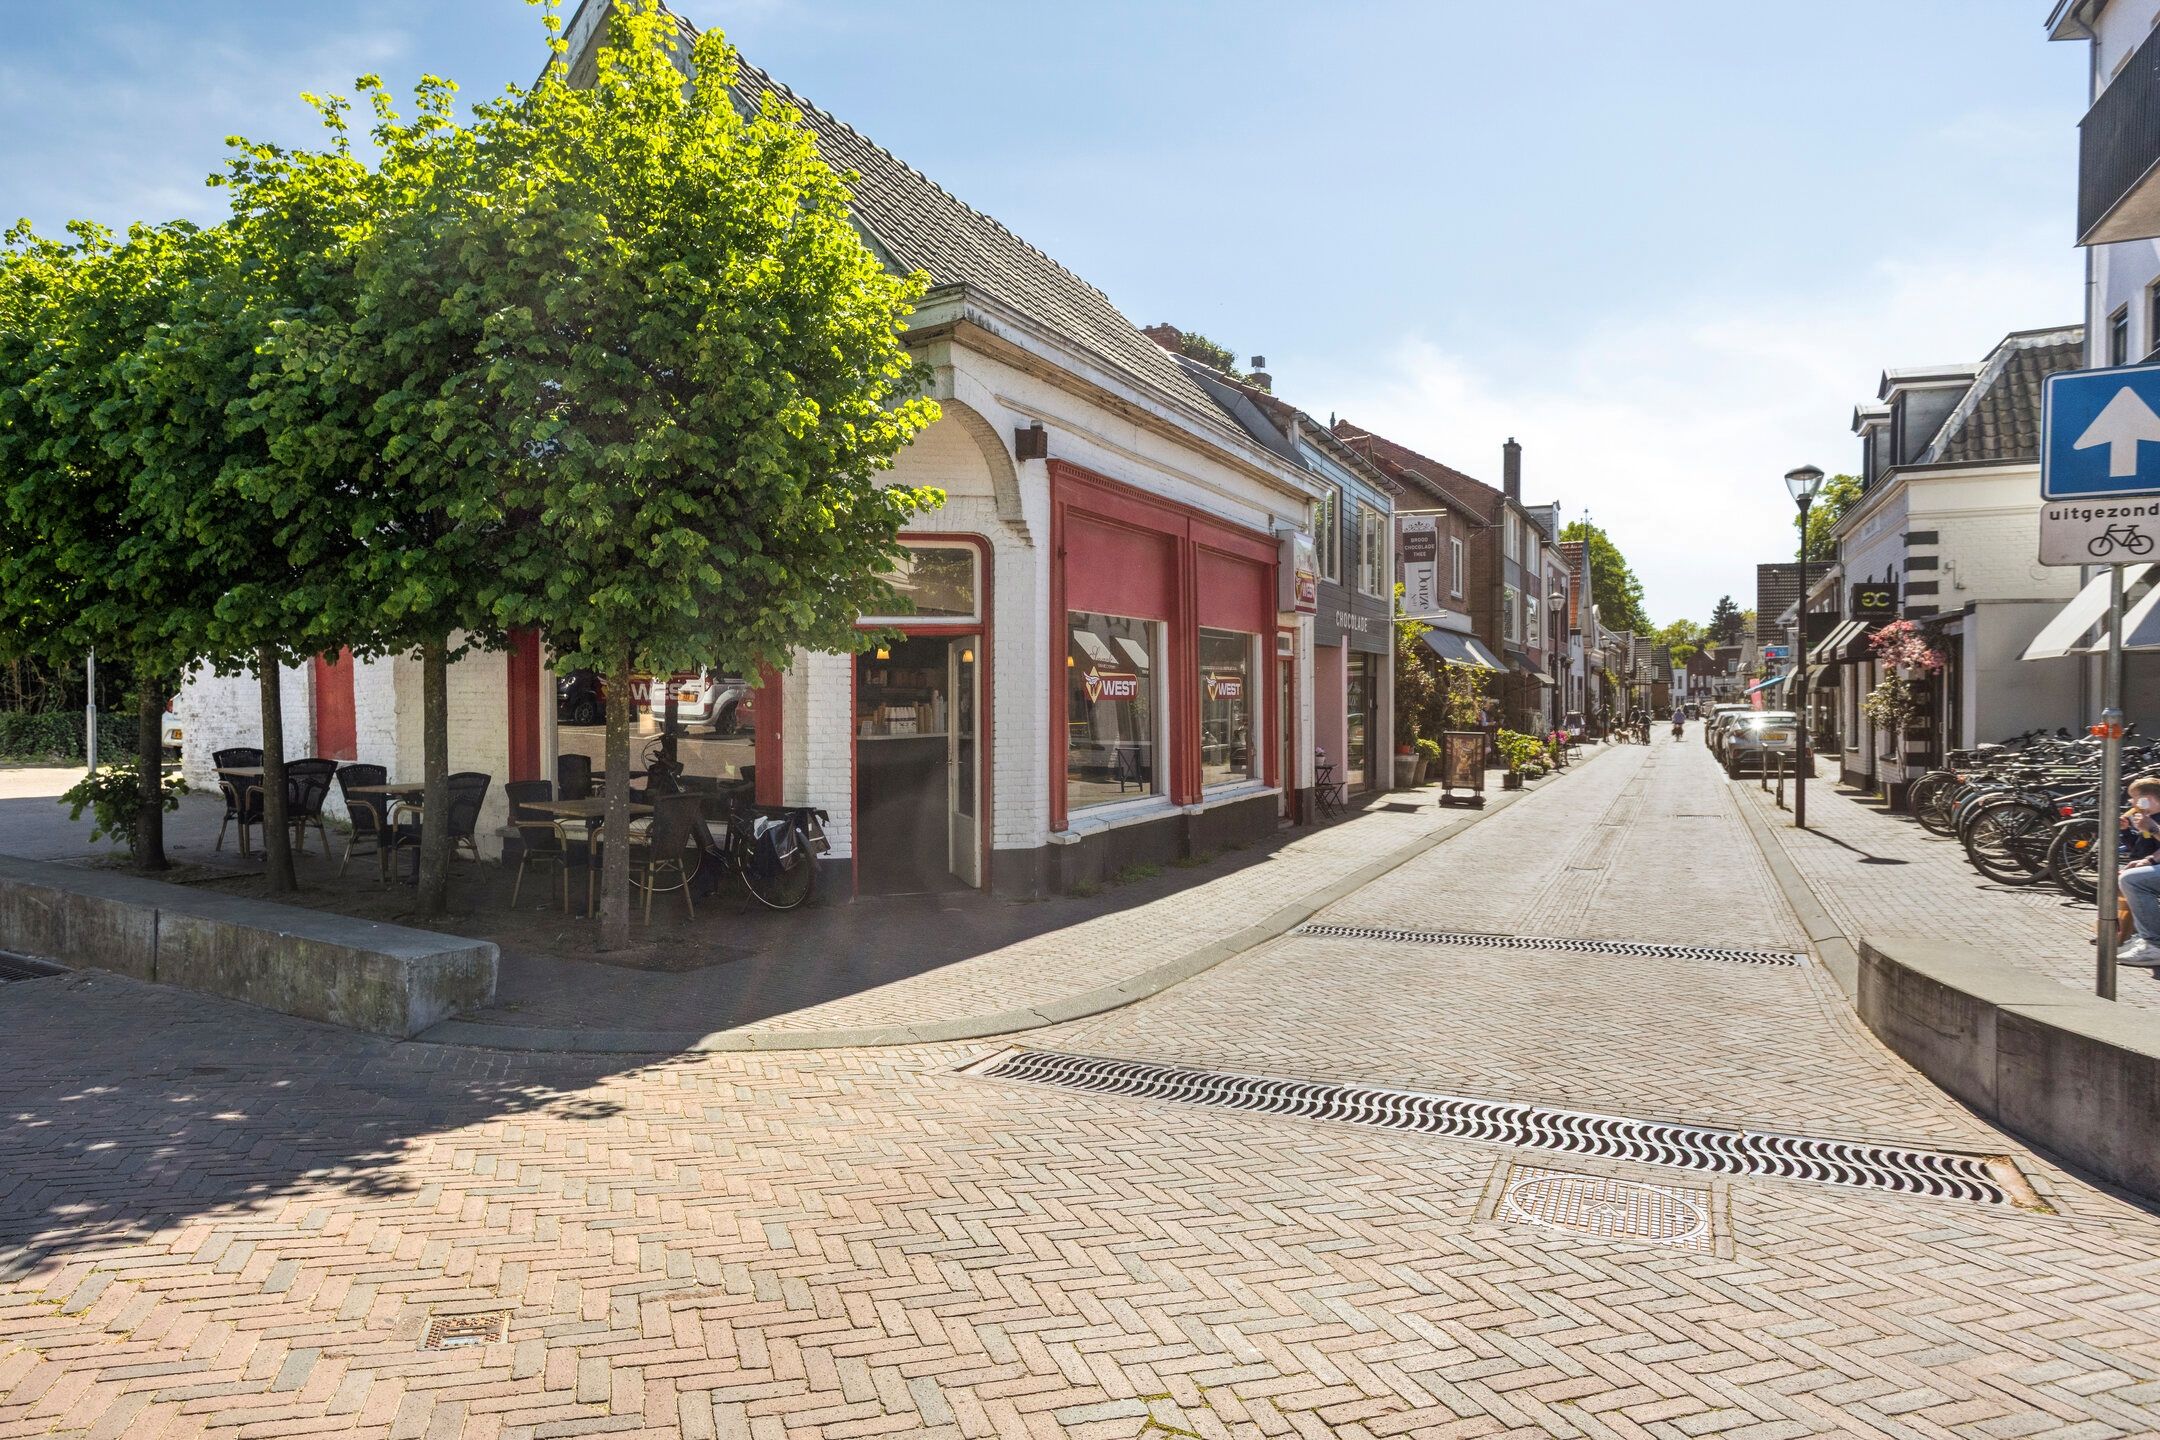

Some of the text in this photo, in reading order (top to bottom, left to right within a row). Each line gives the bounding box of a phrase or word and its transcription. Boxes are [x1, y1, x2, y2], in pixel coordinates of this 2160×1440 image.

[2050, 502, 2160, 523] uitgezond
[1404, 543, 1435, 551] CHOCOLADE
[1336, 610, 1368, 633] CHOCOLADE
[1102, 680, 1137, 696] WEST
[1218, 682, 1241, 696] WEST
